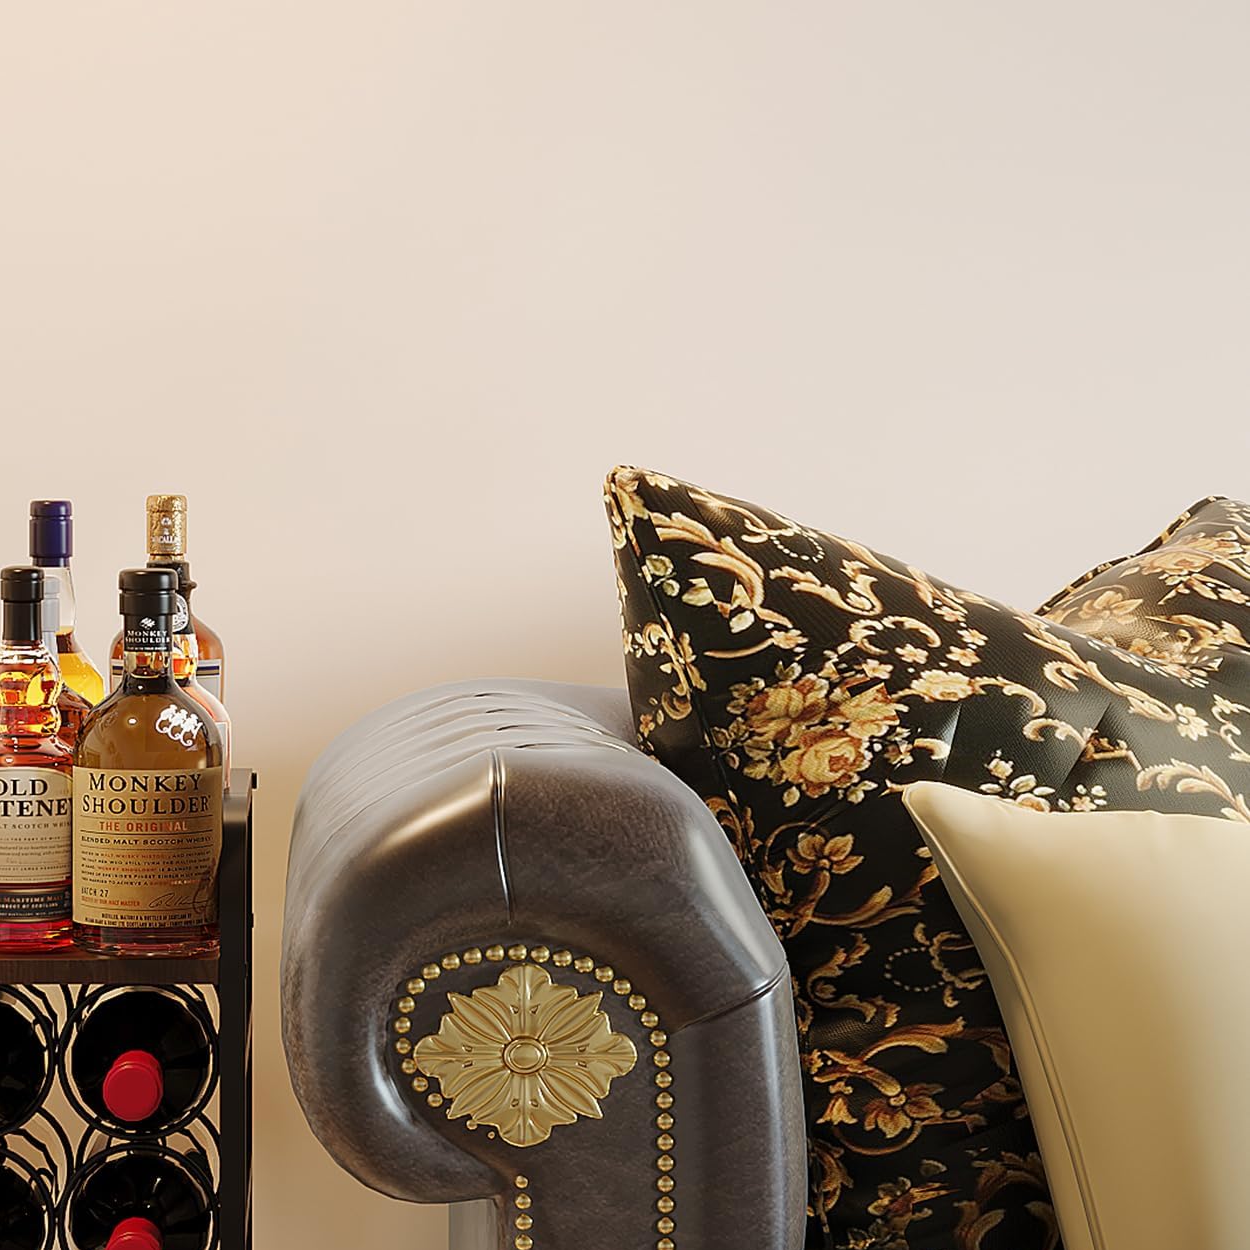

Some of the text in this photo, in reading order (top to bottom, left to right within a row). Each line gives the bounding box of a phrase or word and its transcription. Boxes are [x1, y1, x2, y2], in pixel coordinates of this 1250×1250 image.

[89, 773, 201, 792] MONKEY
[82, 795, 209, 815] SHOULDER
[99, 821, 188, 832] THE ORIGINAL
[113, 838, 140, 846] MALT
[142, 838, 183, 846] SCOTCH
[99, 889, 109, 897] 27
